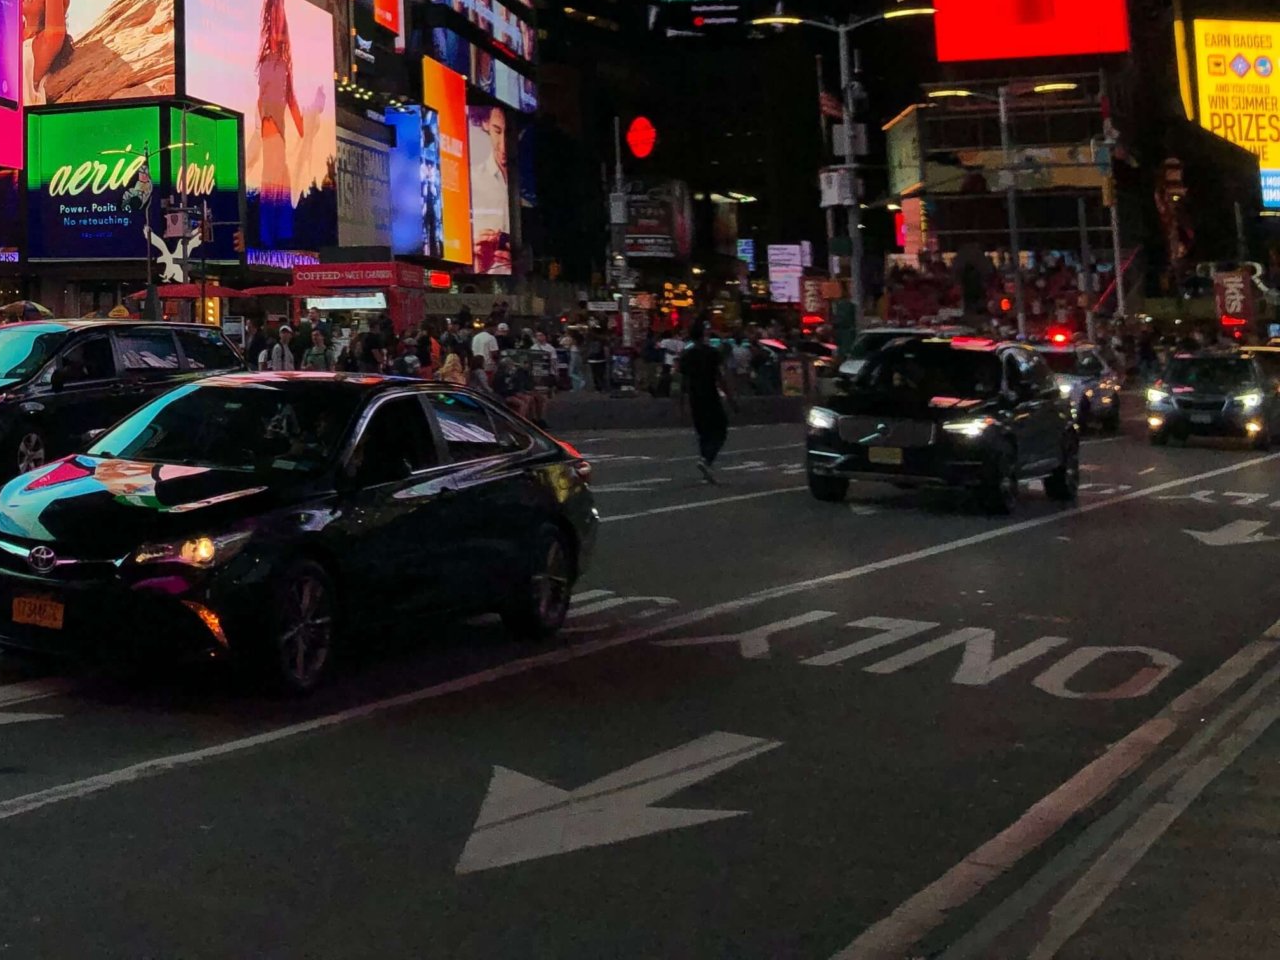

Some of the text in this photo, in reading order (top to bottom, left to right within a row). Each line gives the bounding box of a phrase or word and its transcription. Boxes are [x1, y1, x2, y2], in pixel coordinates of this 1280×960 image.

[1204, 31, 1272, 50] EARN BADGES
[1208, 95, 1278, 112] WIN SUMMER
[1210, 112, 1280, 143] PRIZES
[59, 203, 90, 214] Power.
[63, 215, 133, 227] No retouching.
[296, 270, 340, 281] COFFEED
[662, 609, 1184, 700] ONLY
